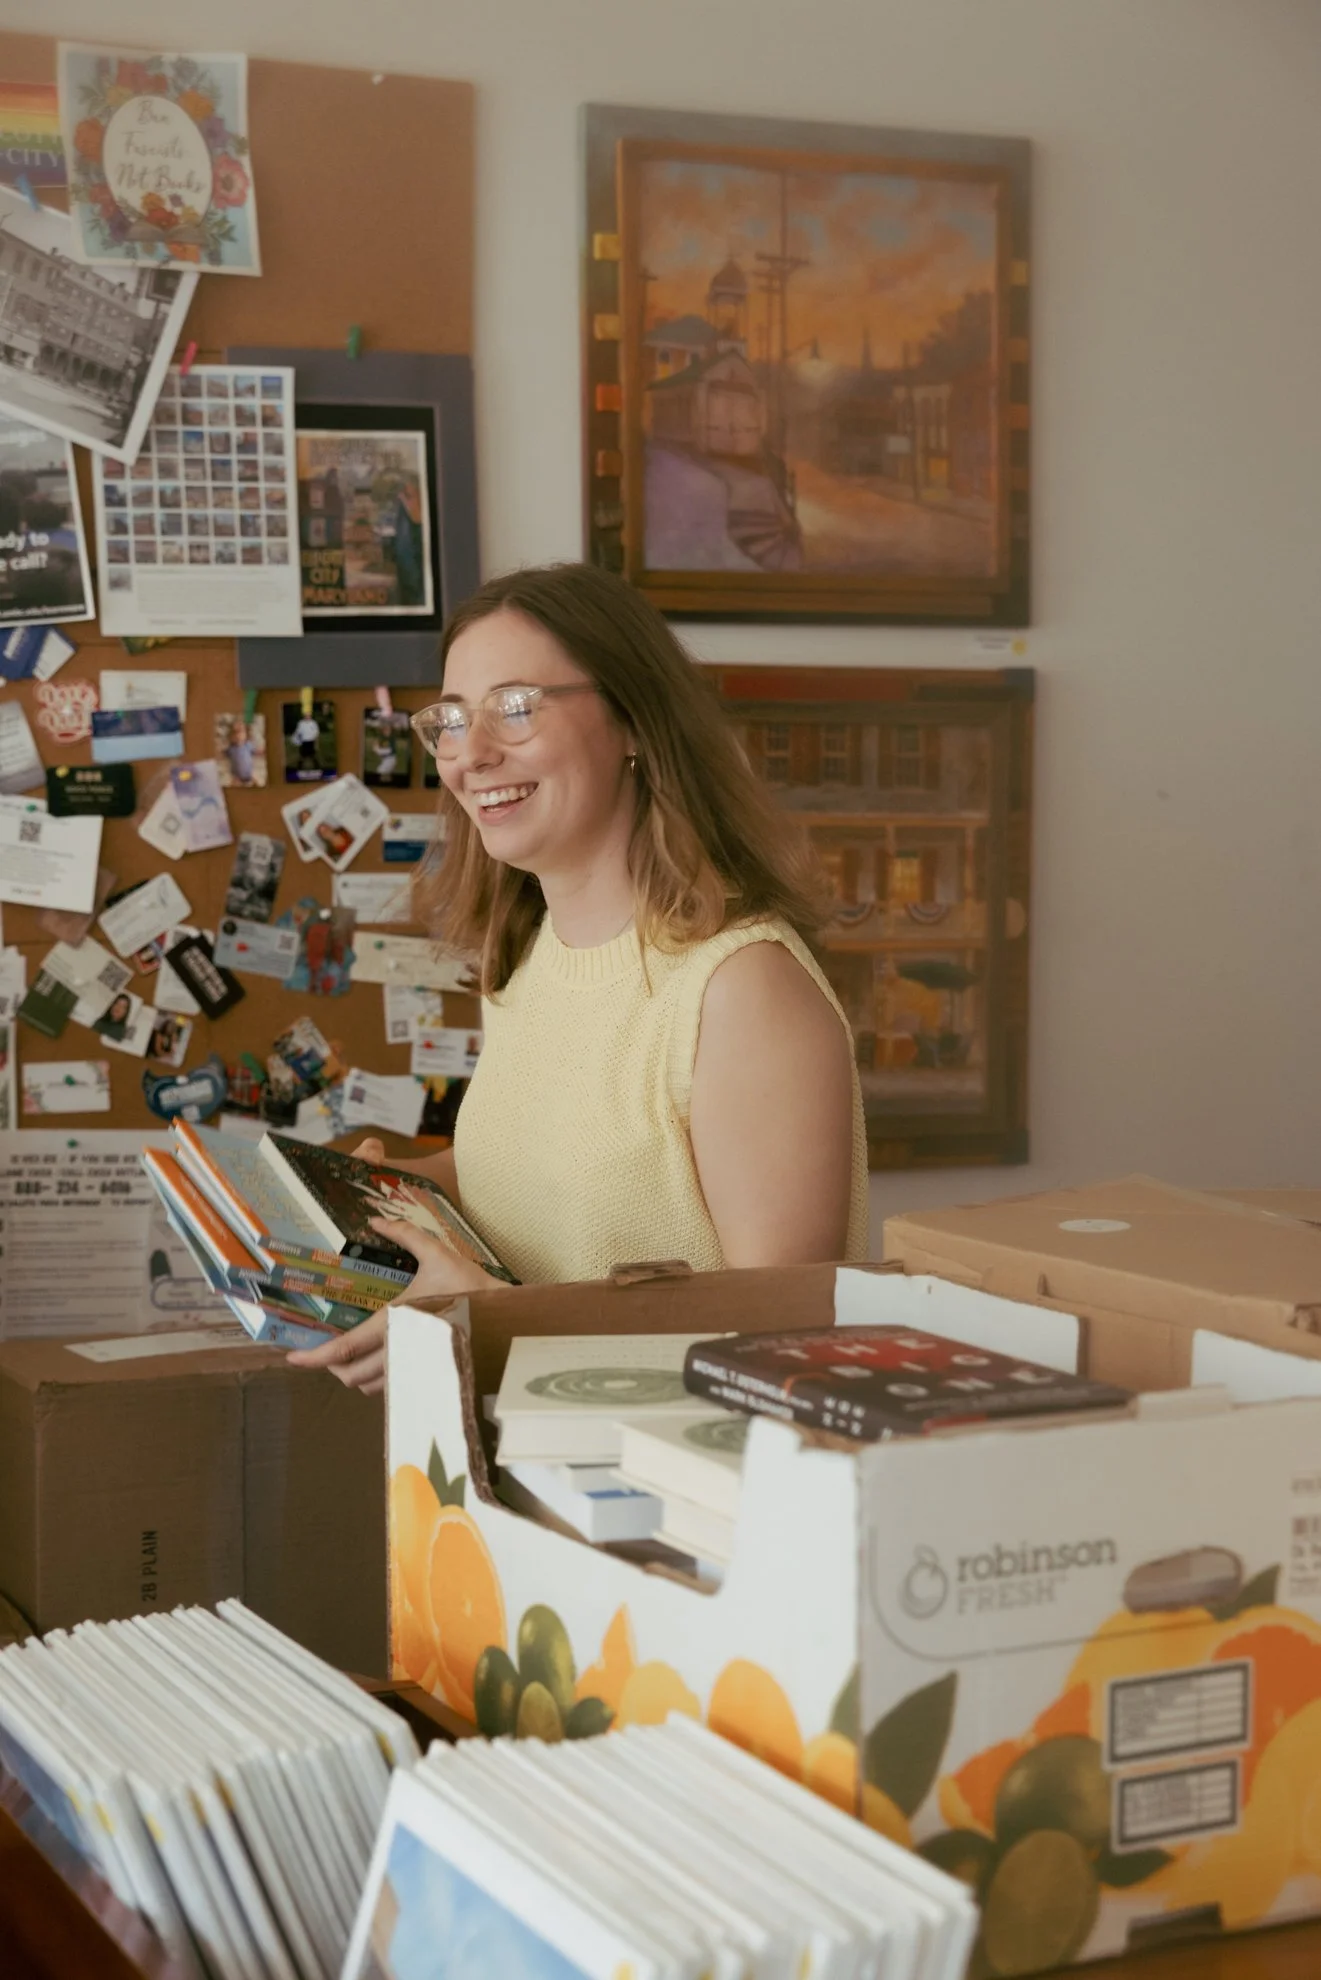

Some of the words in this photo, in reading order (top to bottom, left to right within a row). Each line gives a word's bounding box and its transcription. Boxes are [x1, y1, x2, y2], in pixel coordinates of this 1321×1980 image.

[6, 148, 61, 168] CITY
[117, 163, 149, 189] Not
[29, 532, 50, 547] to
[10, 552, 48, 571] call?
[141, 1530, 158, 1576] PLAIN
[957, 1538, 1118, 1582] robinson
[141, 1582, 158, 1602] 2B
[957, 1579, 1055, 1615] FRESH
